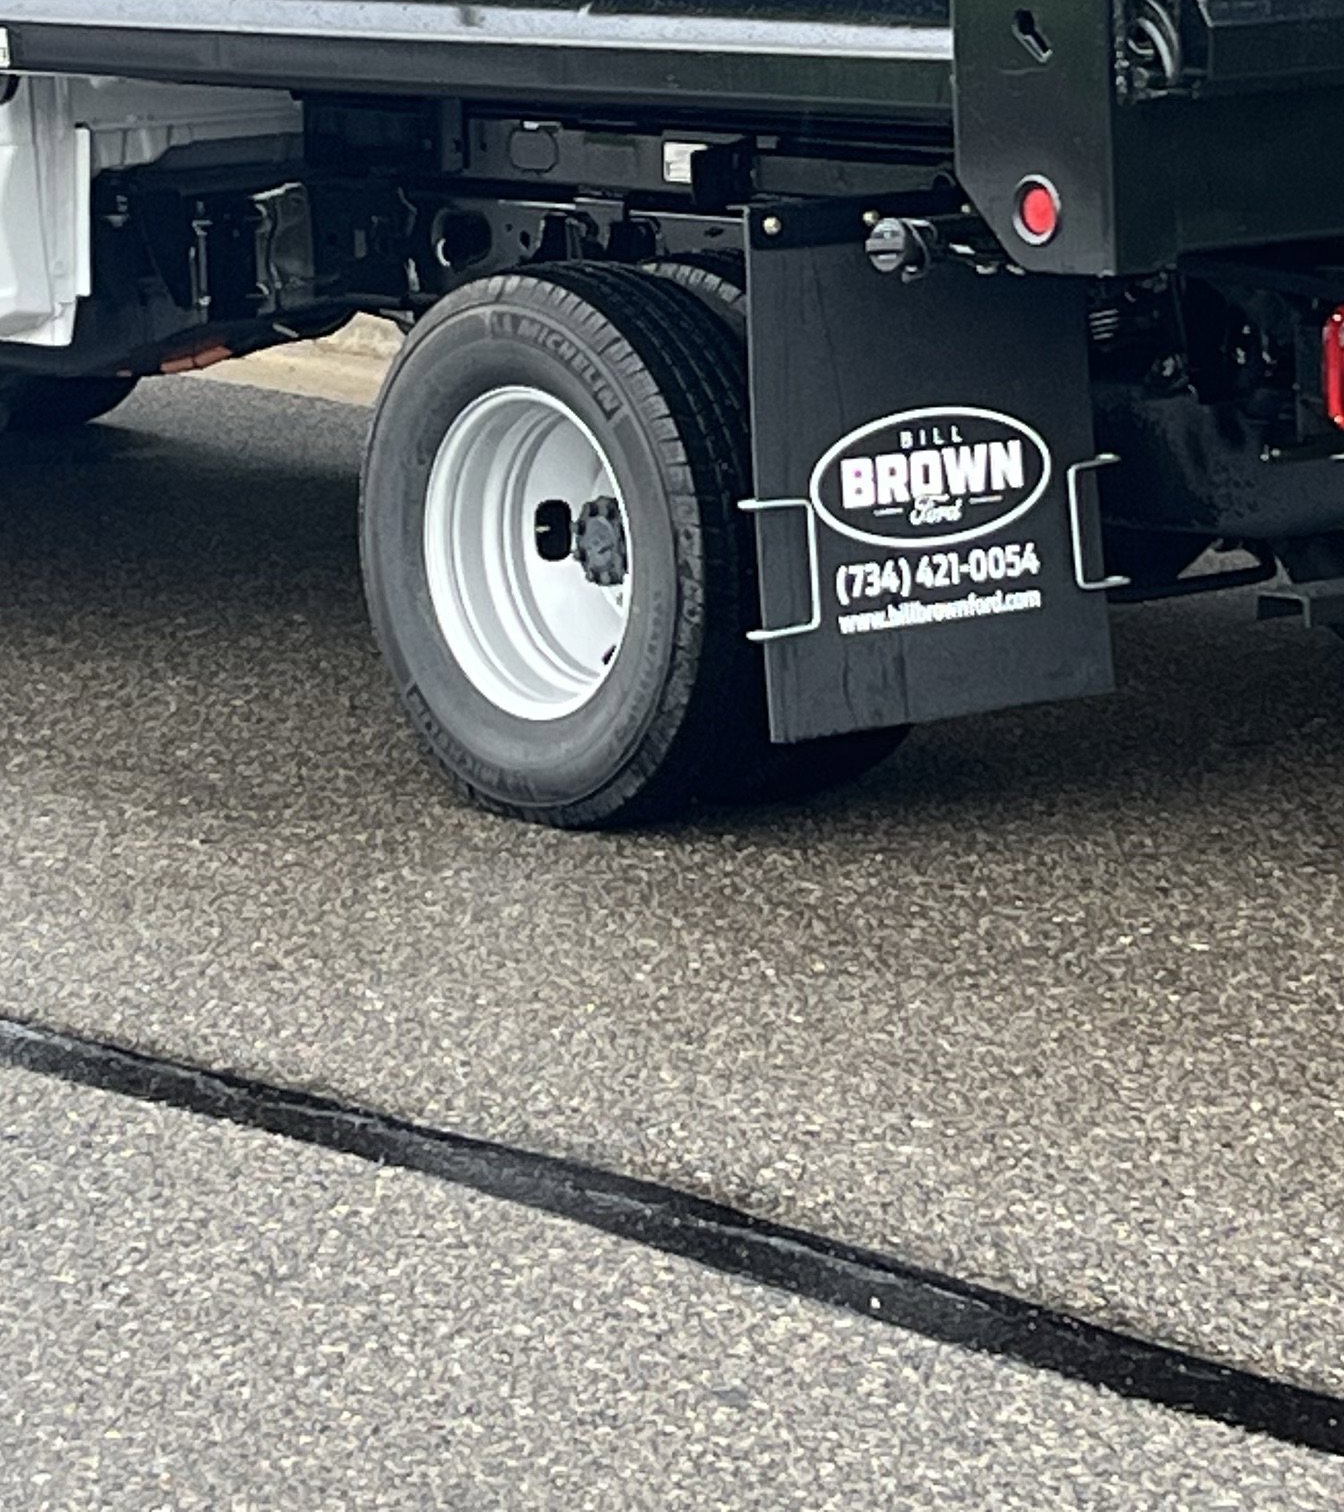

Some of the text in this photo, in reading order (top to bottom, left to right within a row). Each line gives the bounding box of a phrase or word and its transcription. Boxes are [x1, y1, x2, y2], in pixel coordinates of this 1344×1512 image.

[517, 318, 621, 412] MICHELIN
[900, 425, 963, 449] BILL
[840, 440, 1025, 509] BROWN
[909, 493, 963, 526] Ford
[836, 542, 1042, 607] (734) 421-0054
[838, 589, 1042, 635] www.billbrownford.com
